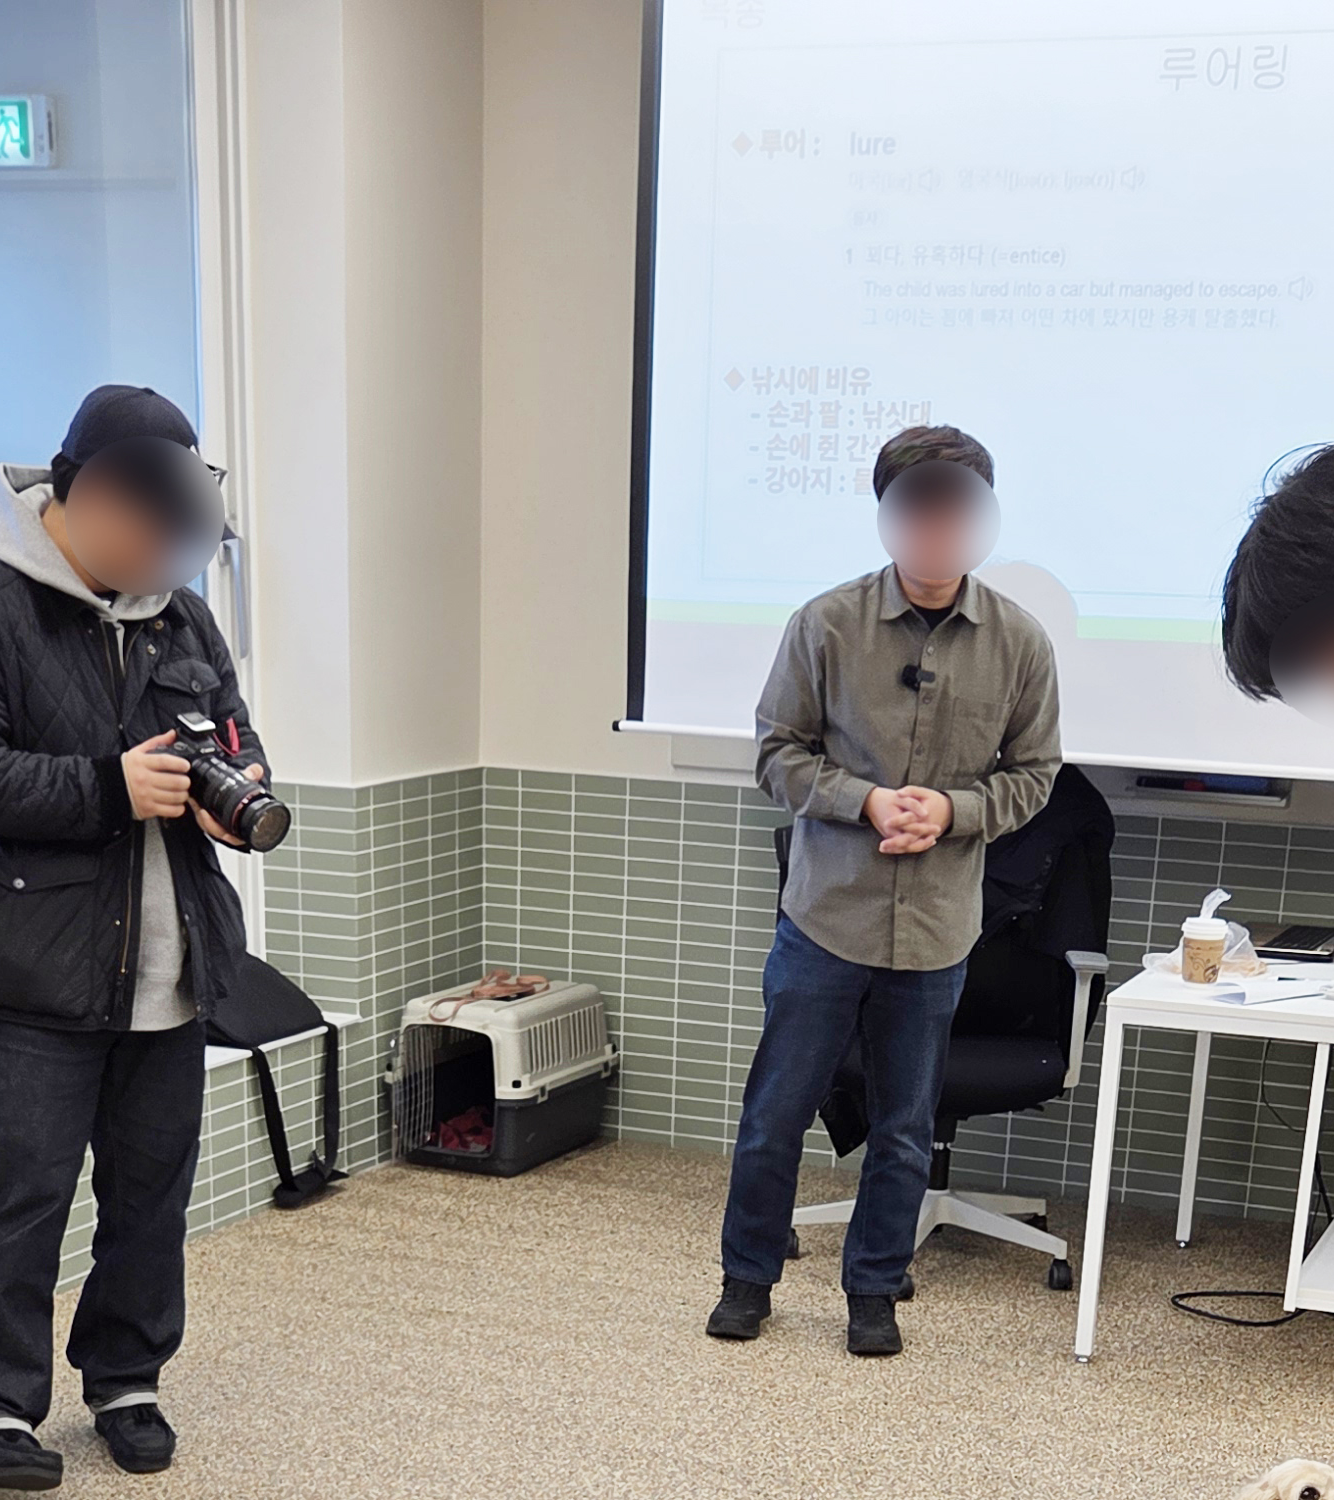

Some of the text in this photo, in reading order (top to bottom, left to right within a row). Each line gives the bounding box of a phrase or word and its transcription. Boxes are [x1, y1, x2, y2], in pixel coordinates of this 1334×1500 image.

[1158, 44, 1288, 92] 루어링
[759, 128, 806, 159] 루어
[850, 131, 897, 156] lure
[912, 243, 985, 266] 유혹하다
[864, 280, 1282, 301] The child was lured into a car but managed to escape.
[862, 307, 879, 327] 그
[884, 307, 934, 327] 아이는
[1020, 307, 1055, 328] 어떤
[1061, 307, 1096, 328] 차에
[1102, 307, 1155, 328] 탔지만
[750, 365, 872, 396] 낚시에 비유
[766, 399, 814, 428] 손과
[818, 399, 843, 429] 팔
[765, 432, 811, 462] 손에
[764, 465, 832, 495] 강아지
